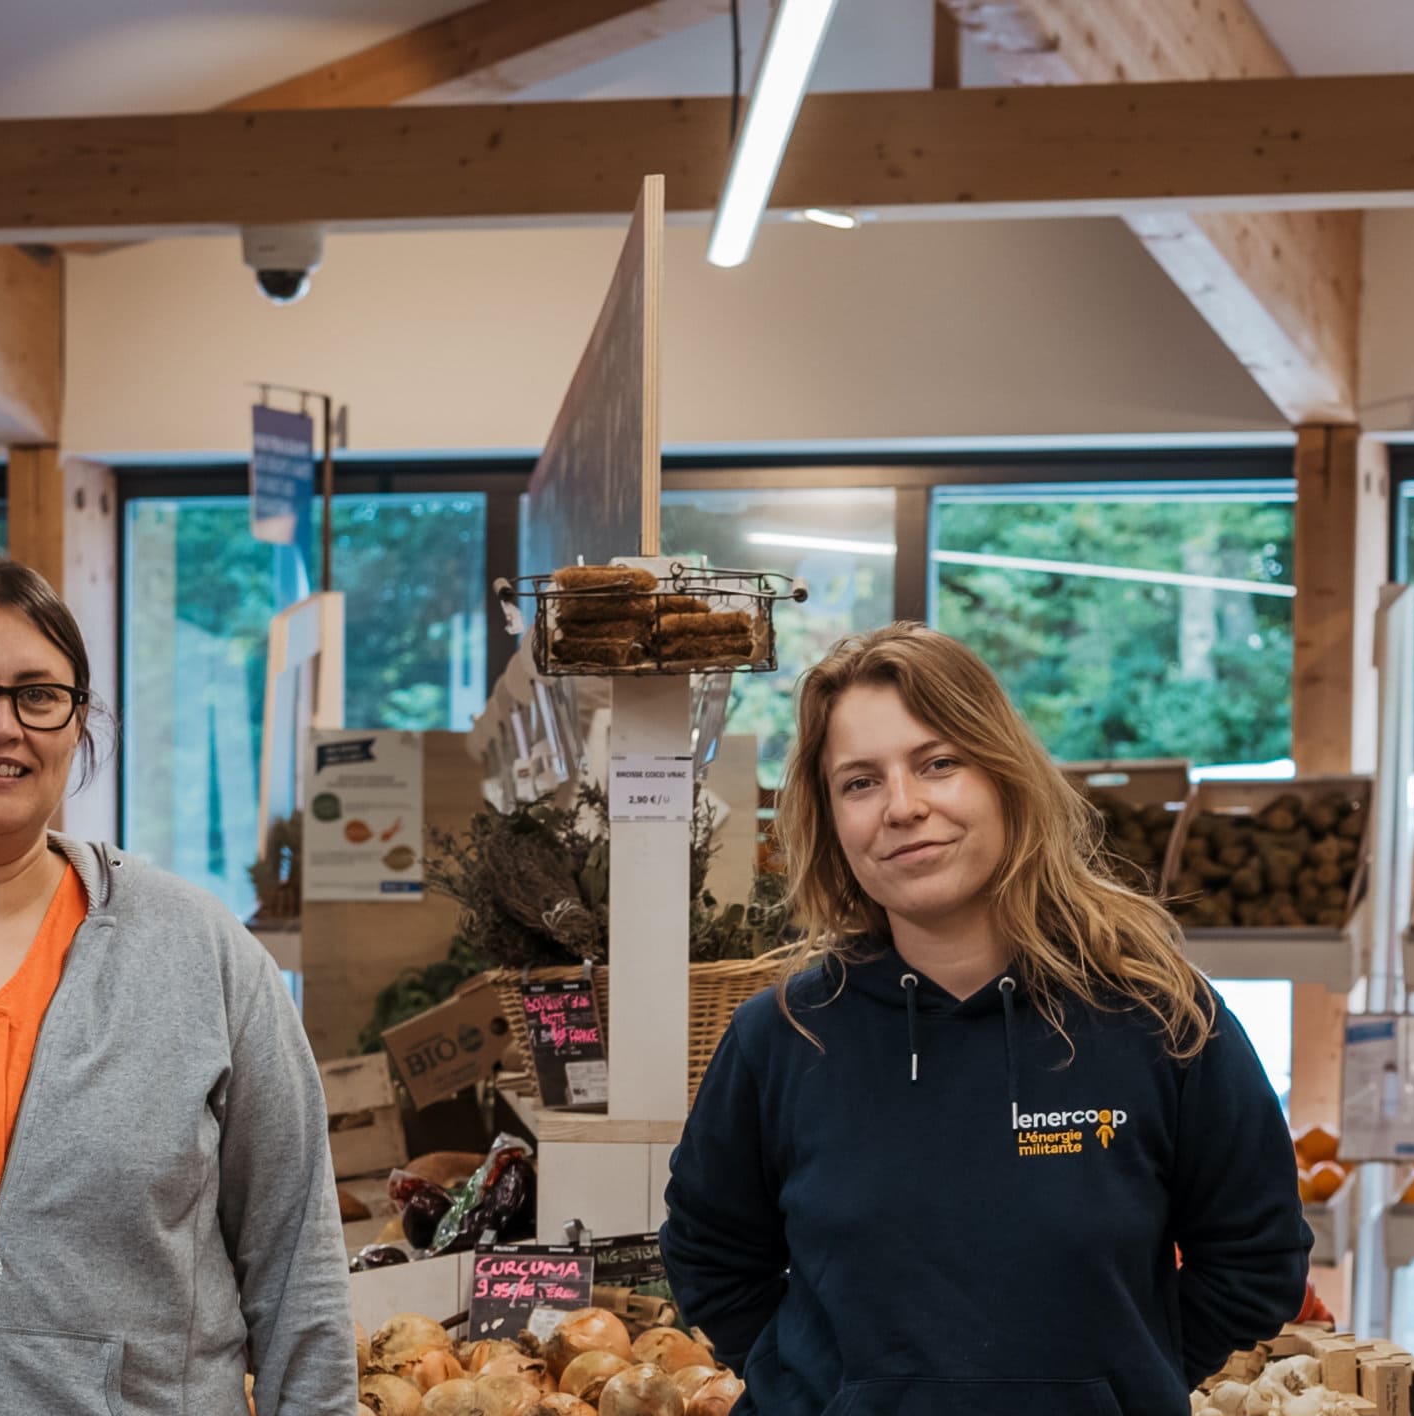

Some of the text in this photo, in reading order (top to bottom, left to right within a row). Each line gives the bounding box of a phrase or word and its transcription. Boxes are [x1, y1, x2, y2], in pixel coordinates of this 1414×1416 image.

[404, 1037, 458, 1078] BIO
[1018, 1129, 1083, 1144] L'énergie
[1018, 1142, 1083, 1157] militante
[475, 1257, 581, 1280] CURCUMA
